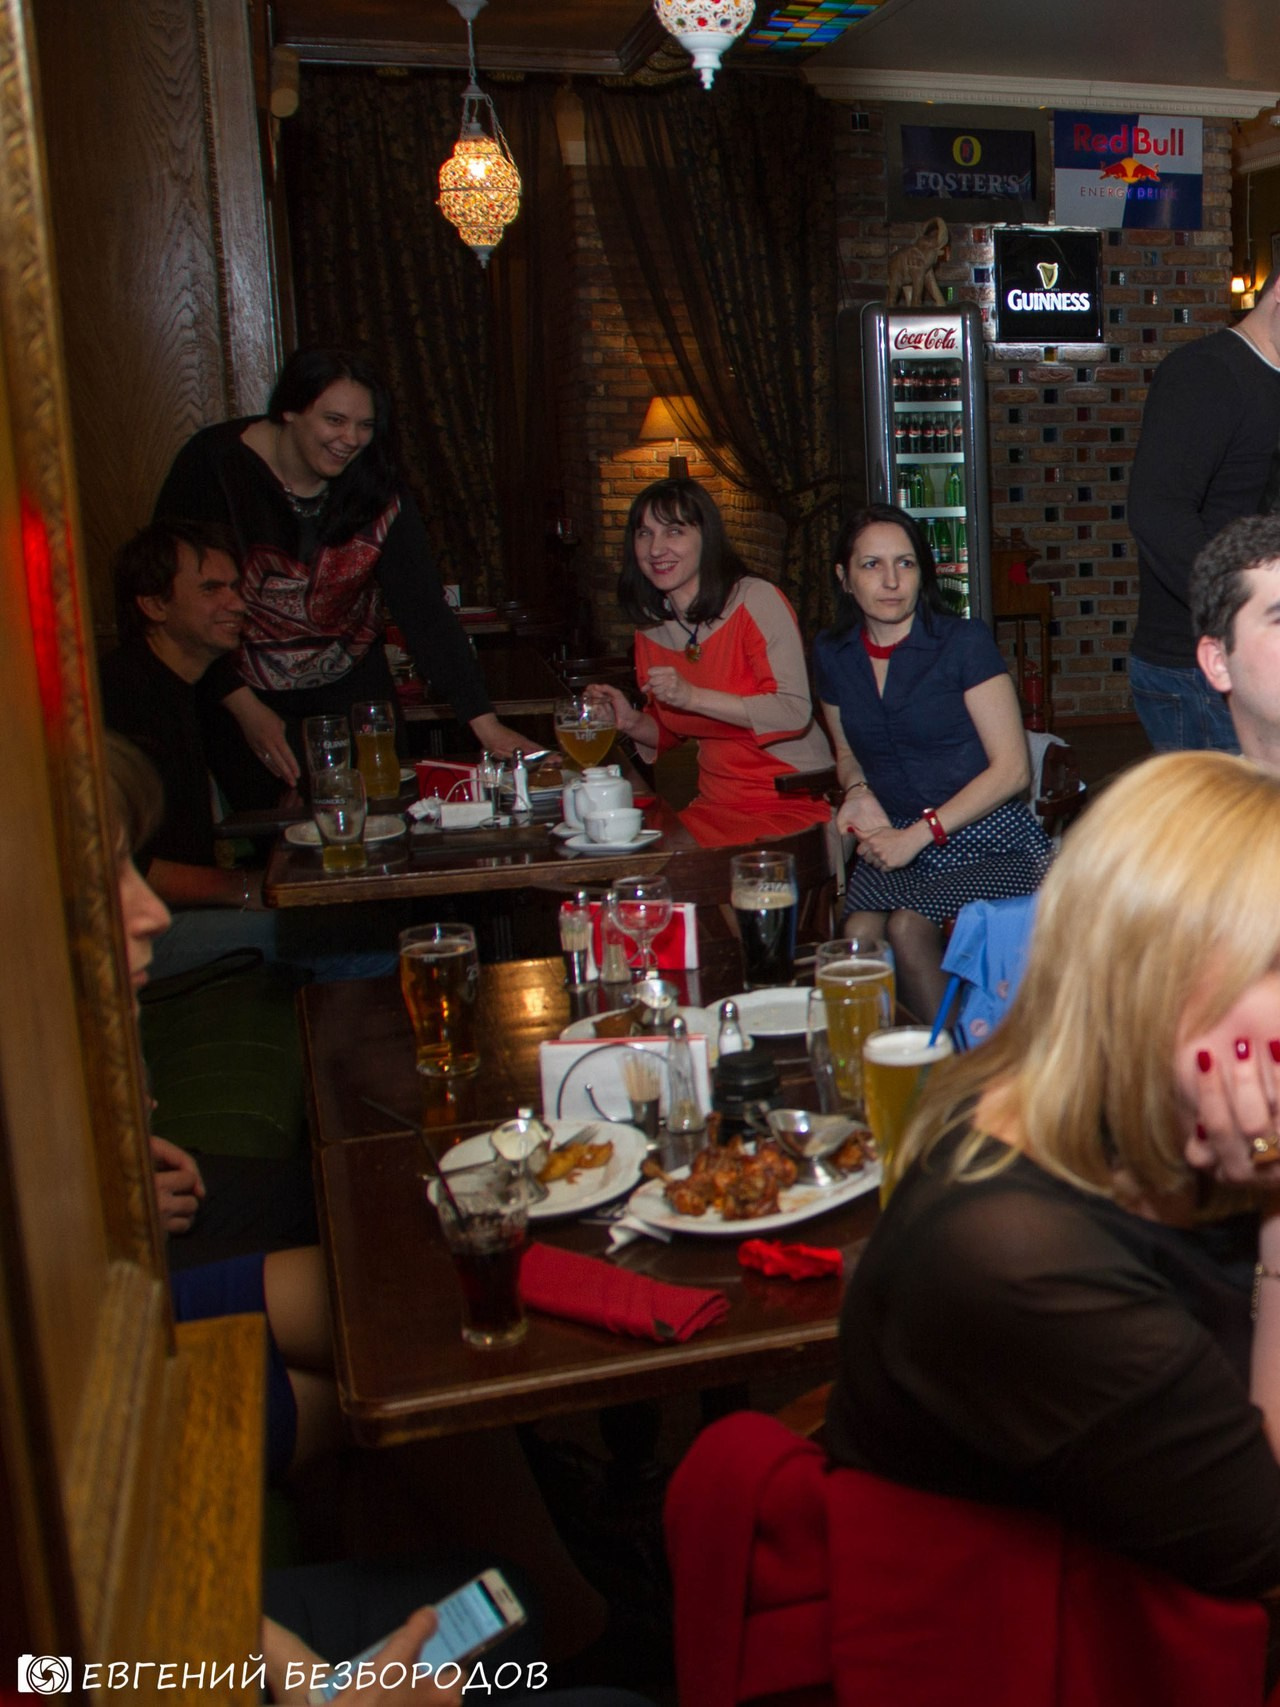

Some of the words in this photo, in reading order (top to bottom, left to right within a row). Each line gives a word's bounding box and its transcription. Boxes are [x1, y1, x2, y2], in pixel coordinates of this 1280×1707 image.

[1073, 123, 1129, 153] Red
[1132, 126, 1184, 156] Bull
[915, 171, 1020, 194] FOSTER'S
[1080, 186, 1134, 199] ENERGY
[1007, 289, 1090, 311] GUINNESS
[894, 328, 958, 350] Coca-Cola
